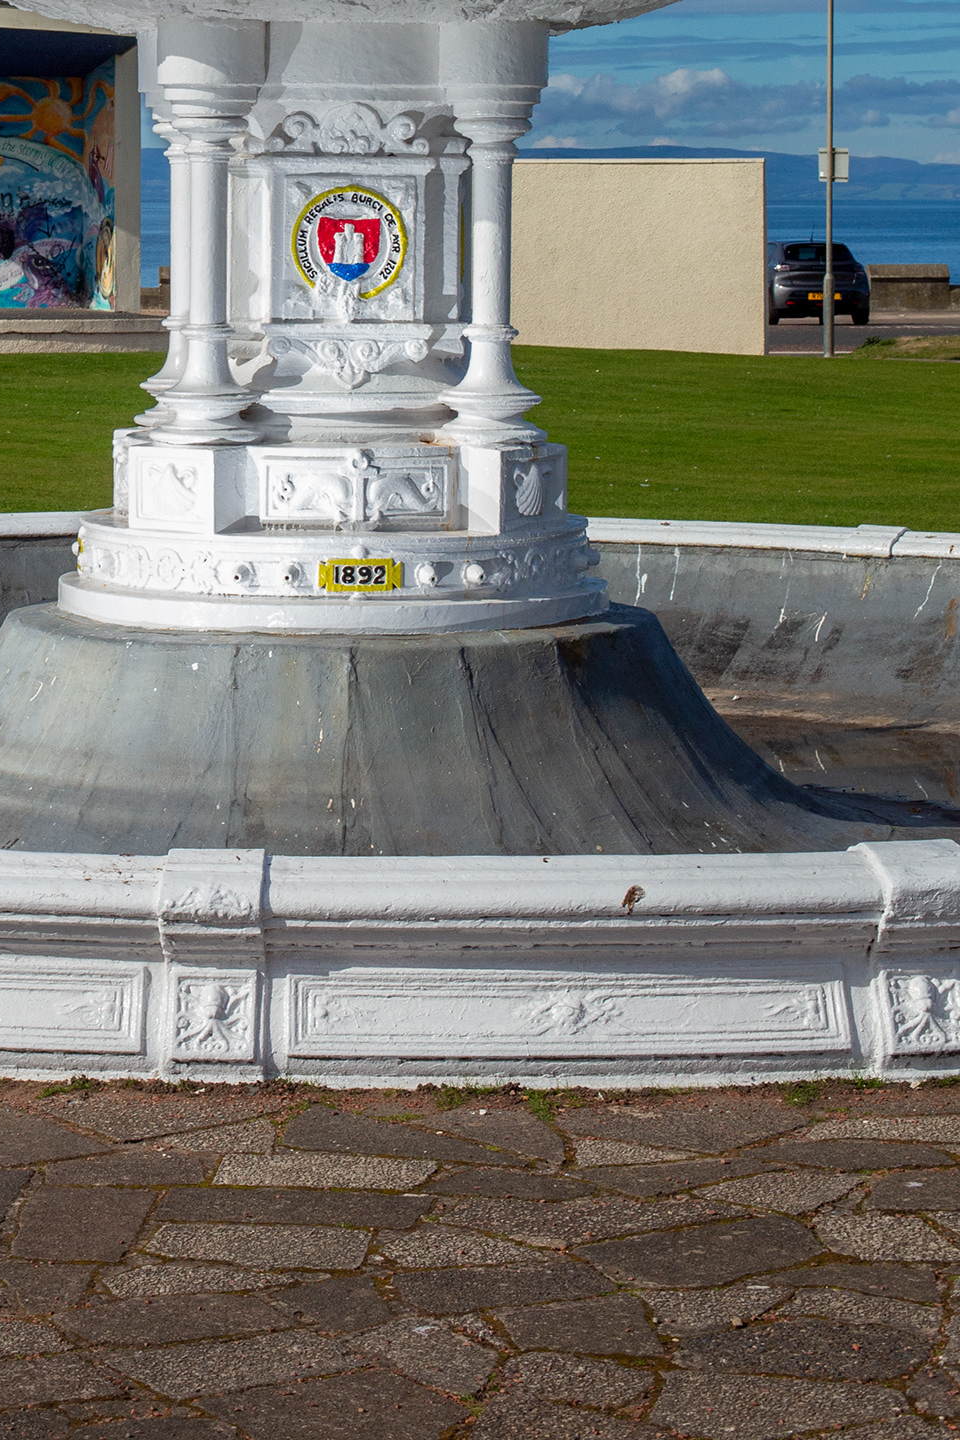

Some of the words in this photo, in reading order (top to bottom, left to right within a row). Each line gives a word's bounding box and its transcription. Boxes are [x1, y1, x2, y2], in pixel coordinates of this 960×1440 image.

[2, 142, 16, 153] the
[392, 234, 401, 253] AYR
[379, 259, 397, 280] 1202
[334, 565, 386, 584] 1892
